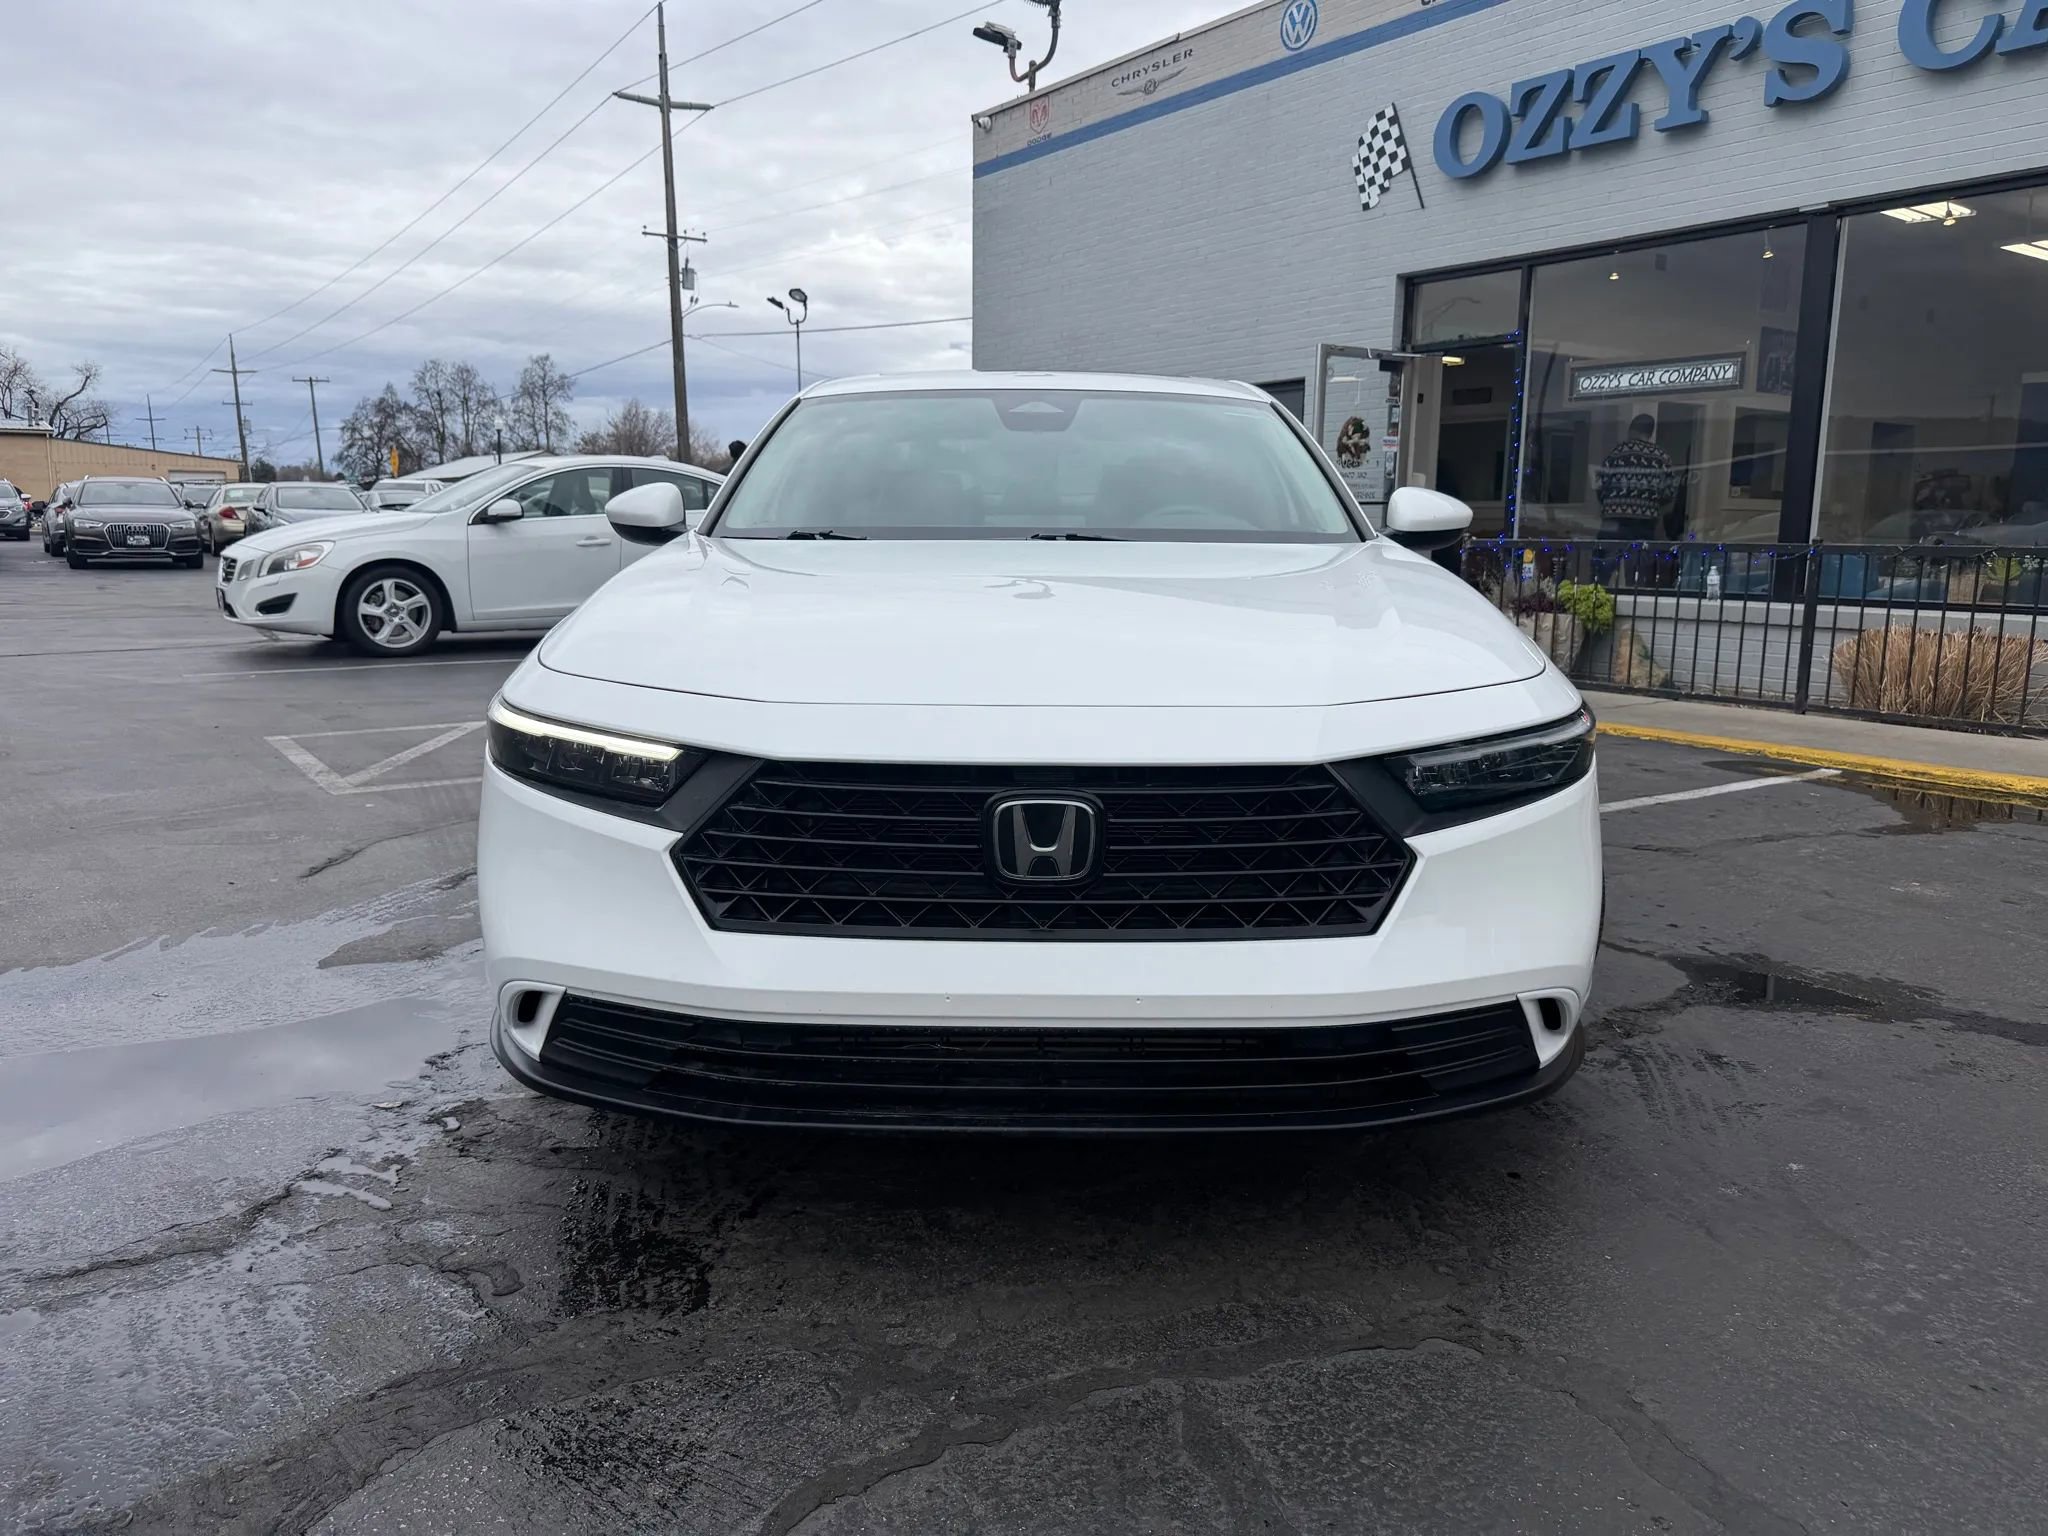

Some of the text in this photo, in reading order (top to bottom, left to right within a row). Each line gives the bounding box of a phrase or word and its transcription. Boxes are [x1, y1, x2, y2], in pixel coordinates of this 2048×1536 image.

[1111, 48, 1194, 88] CHRYSLER
[1580, 364, 1732, 391] OZZY'S CAR COMPANY
